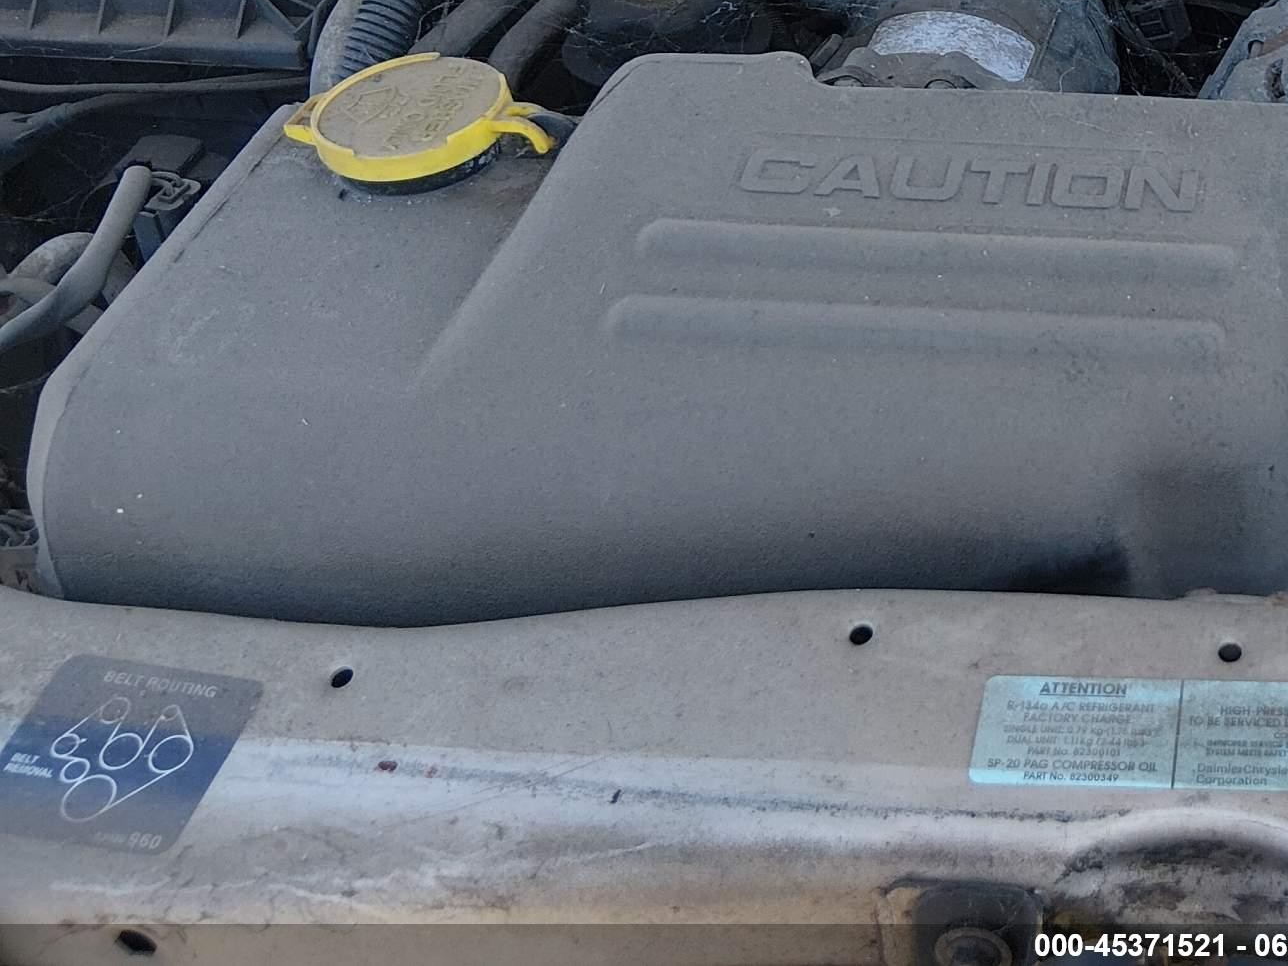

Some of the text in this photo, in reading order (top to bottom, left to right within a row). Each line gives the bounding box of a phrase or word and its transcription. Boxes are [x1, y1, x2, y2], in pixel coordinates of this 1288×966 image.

[739, 148, 1198, 212] CAUTION
[103, 670, 218, 698] BELT ROUTING
[1040, 681, 1128, 696] ATTENTION
[1051, 701, 1077, 713] A/C
[1079, 702, 1155, 714] REFRIGERANT
[1023, 713, 1132, 725] FACTORY CHARGE
[1190, 715, 1204, 726] TO
[1207, 716, 1221, 727] BE
[1223, 717, 1280, 728] SERVICED
[10, 752, 40, 764] BELT
[1023, 759, 1048, 770] PAG
[1052, 760, 1136, 772] COMPRESSOR
[1138, 762, 1158, 772] OIL
[1023, 771, 1048, 781] PART
[1070, 772, 1120, 783] 82300349
[1195, 774, 1268, 786] Corporation
